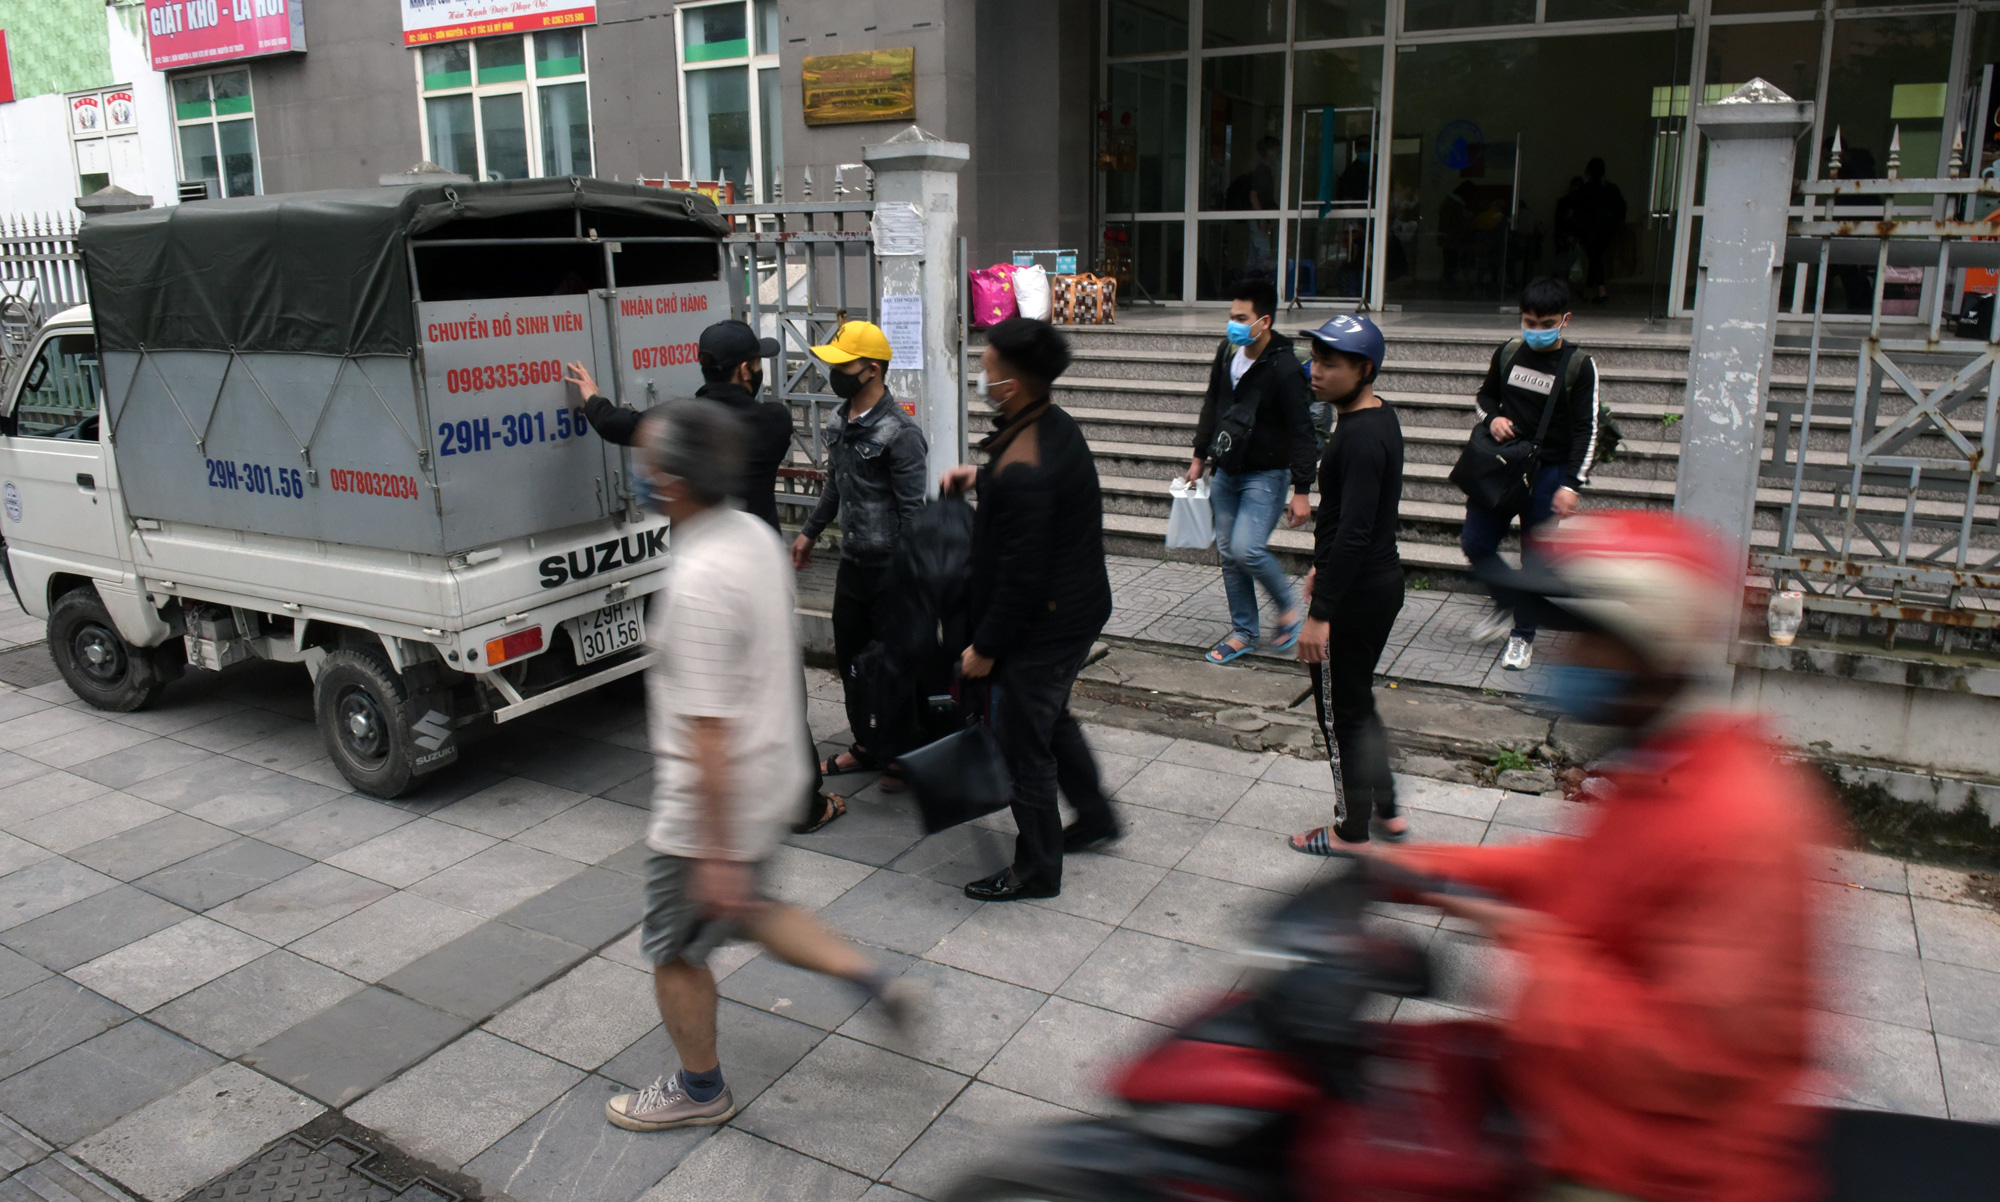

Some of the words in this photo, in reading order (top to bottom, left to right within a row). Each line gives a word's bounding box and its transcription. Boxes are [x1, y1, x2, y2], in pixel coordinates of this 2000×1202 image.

[621, 296, 653, 319] NHẬN
[656, 292, 678, 314] CHỞ
[680, 293, 708, 313] HÀNG
[428, 313, 489, 343] CHUYỂN
[492, 311, 512, 337] ĐỒ
[516, 315, 550, 335] SINH
[553, 311, 583, 333] VIÊN
[632, 342, 699, 370] 09780320
[447, 359, 562, 394] 0983353609
[1514, 373, 1550, 388] adidas
[438, 407, 588, 457] 29H-301.56
[206, 458, 304, 499] 29H-301.56
[330, 468, 419, 500] 0978032034
[539, 524, 671, 589] SUZUK
[593, 603, 624, 629] 29H
[584, 619, 639, 658] 301.56
[415, 746, 455, 766] SUZUKI
